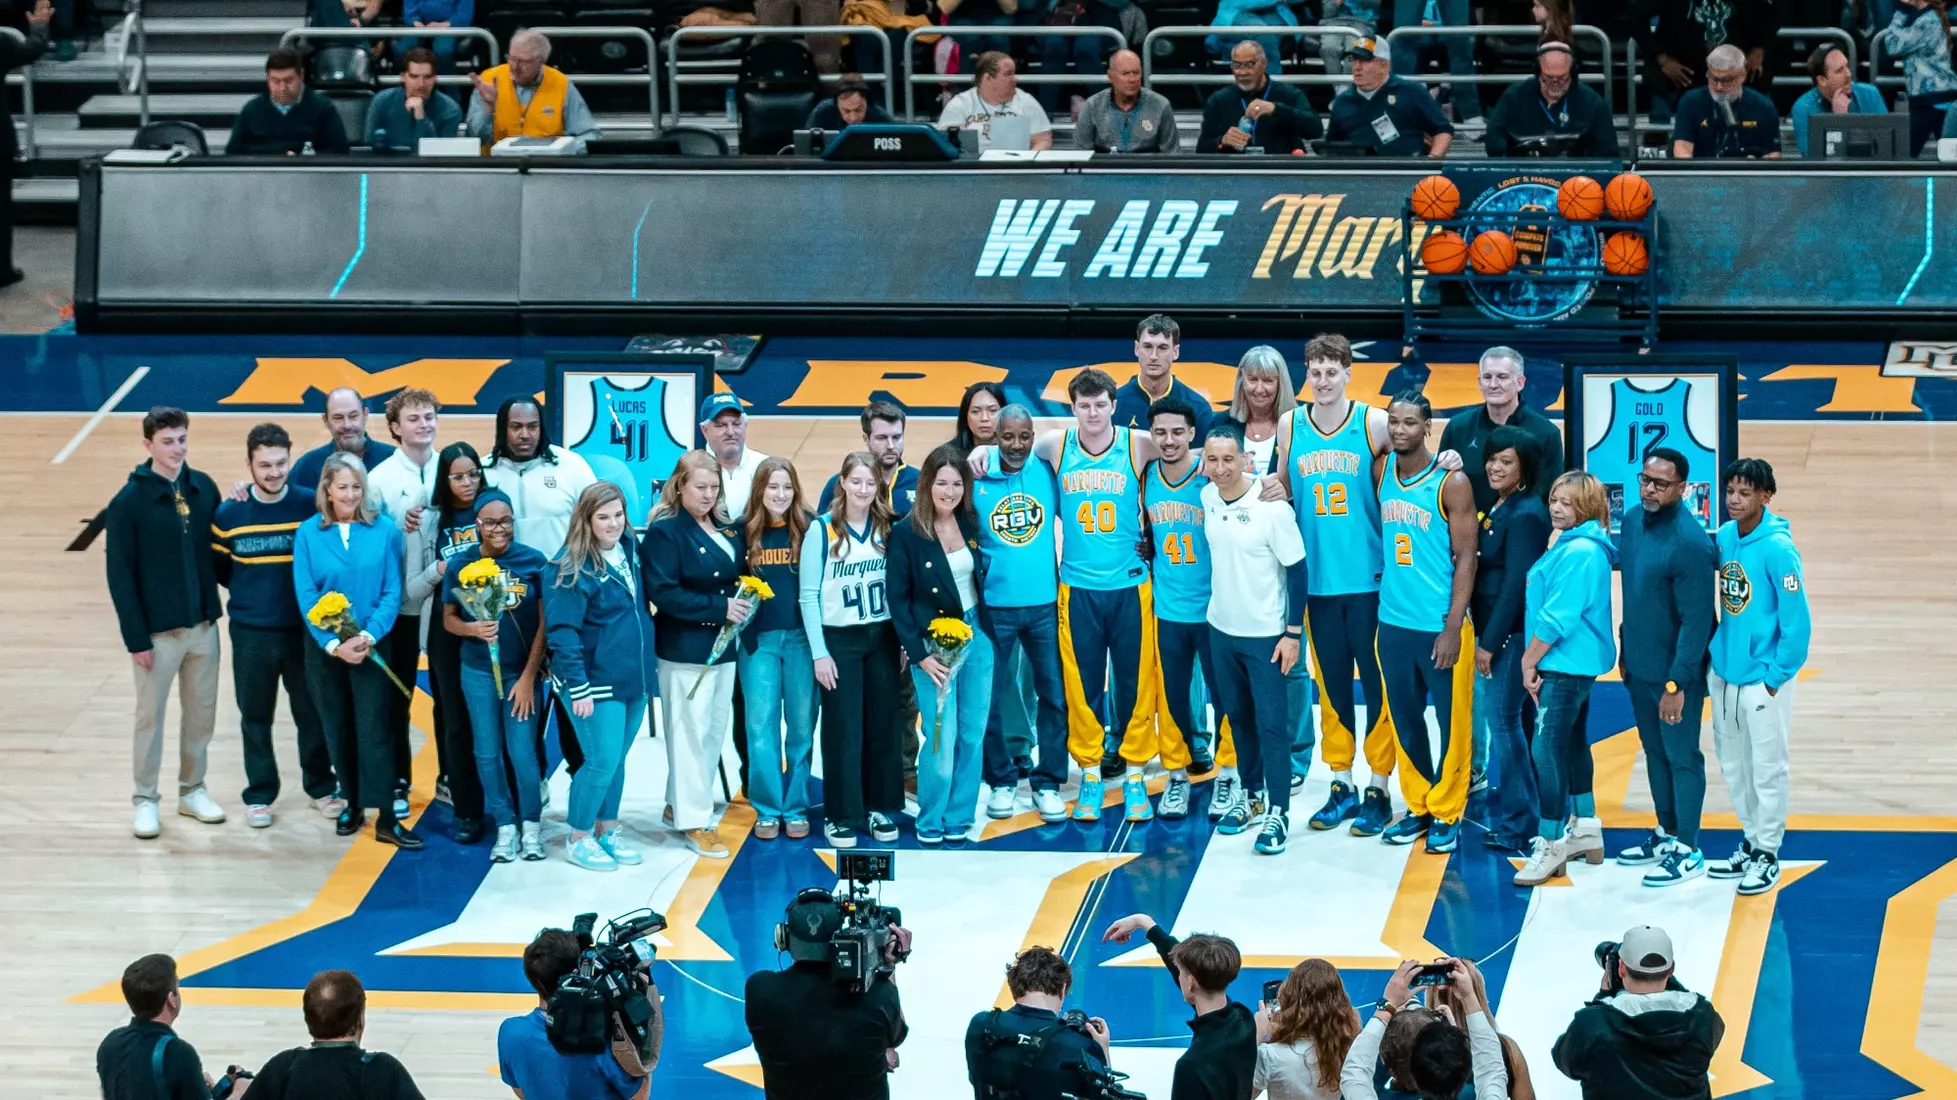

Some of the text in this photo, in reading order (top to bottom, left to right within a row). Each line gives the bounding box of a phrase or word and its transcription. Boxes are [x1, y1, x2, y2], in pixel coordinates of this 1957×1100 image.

[874, 137, 902, 150] POSS
[975, 199, 1095, 277] WE
[1083, 199, 1239, 278] ARE
[611, 400, 647, 414] LUCAS
[1635, 402, 1664, 415] GOLD
[609, 419, 649, 462] 41
[1628, 421, 1670, 464] 12
[1297, 449, 1361, 478] MARQUETTE
[1062, 469, 1127, 496] MARQUETTE
[1312, 482, 1349, 517] 12
[1382, 499, 1433, 532] MARQUETTE
[1076, 500, 1117, 534] 40
[1163, 532, 1198, 565] 41
[1395, 533, 1414, 567] 2
[841, 578, 887, 621] 40
[1782, 574, 1800, 592] MU
